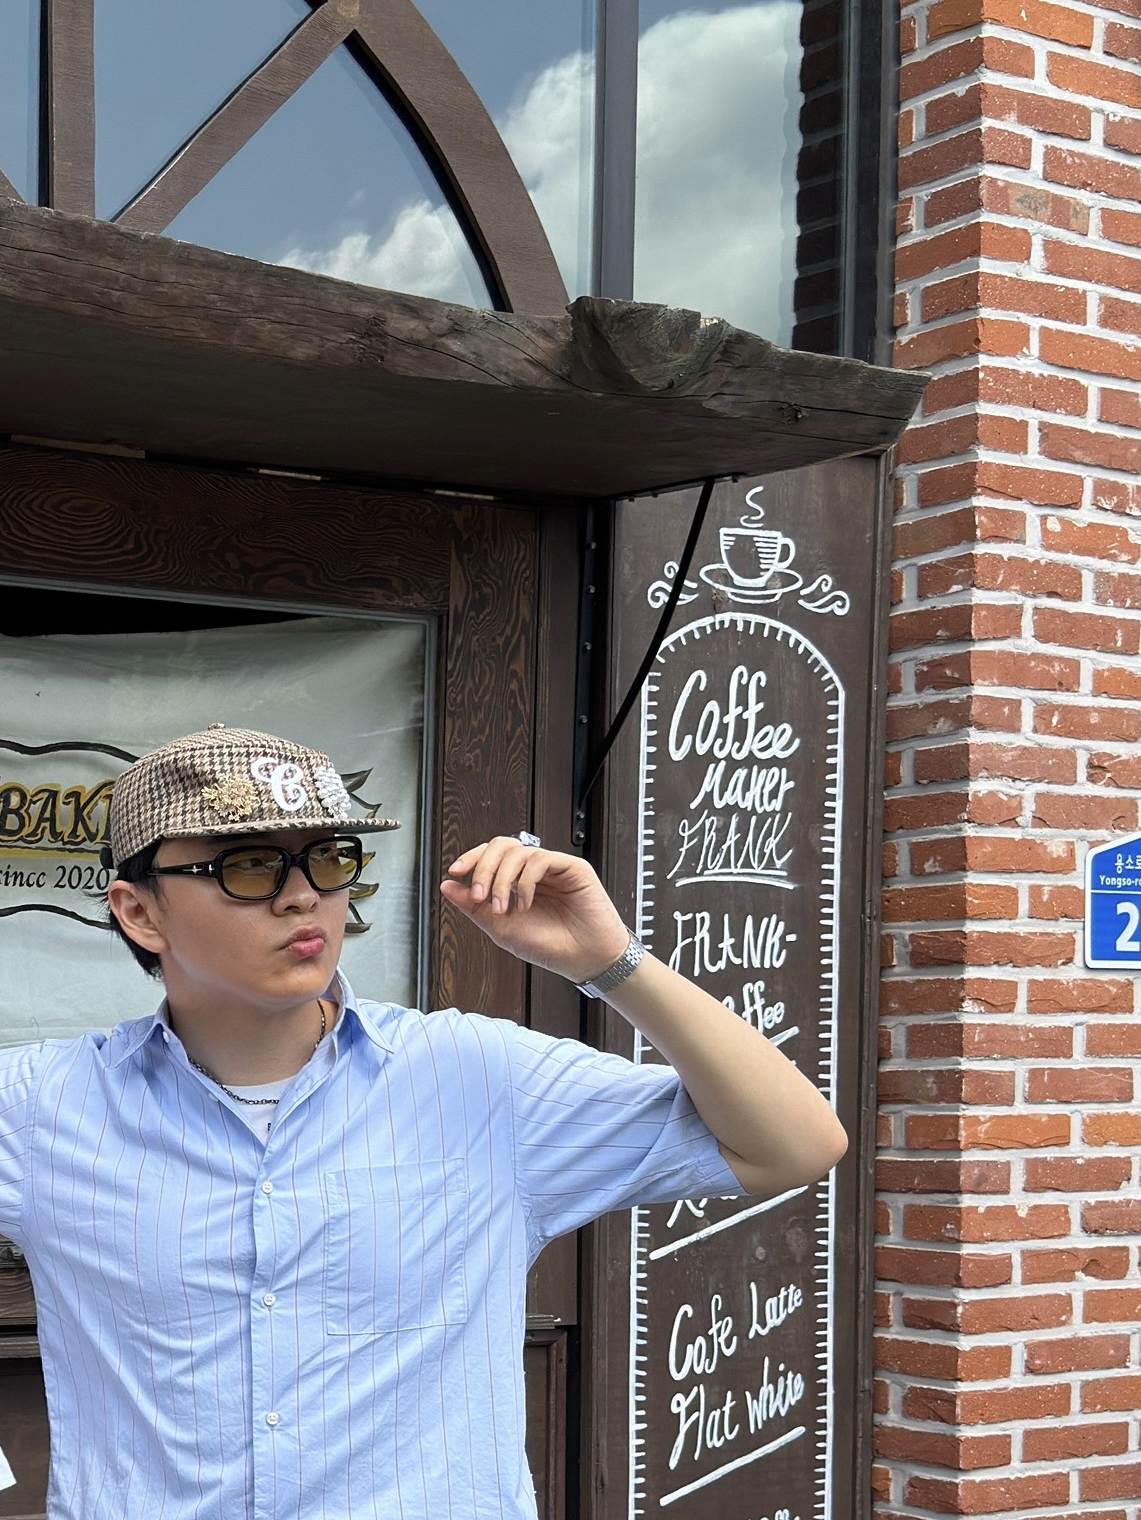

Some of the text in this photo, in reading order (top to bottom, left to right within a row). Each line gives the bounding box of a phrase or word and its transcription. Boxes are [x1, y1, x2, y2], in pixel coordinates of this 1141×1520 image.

[668, 664, 800, 762] Coffee
[666, 811, 793, 880] FRANK
[54, 865, 111, 892] 2020
[721, 980, 785, 1035] ffee
[749, 1281, 803, 1339] Latte
